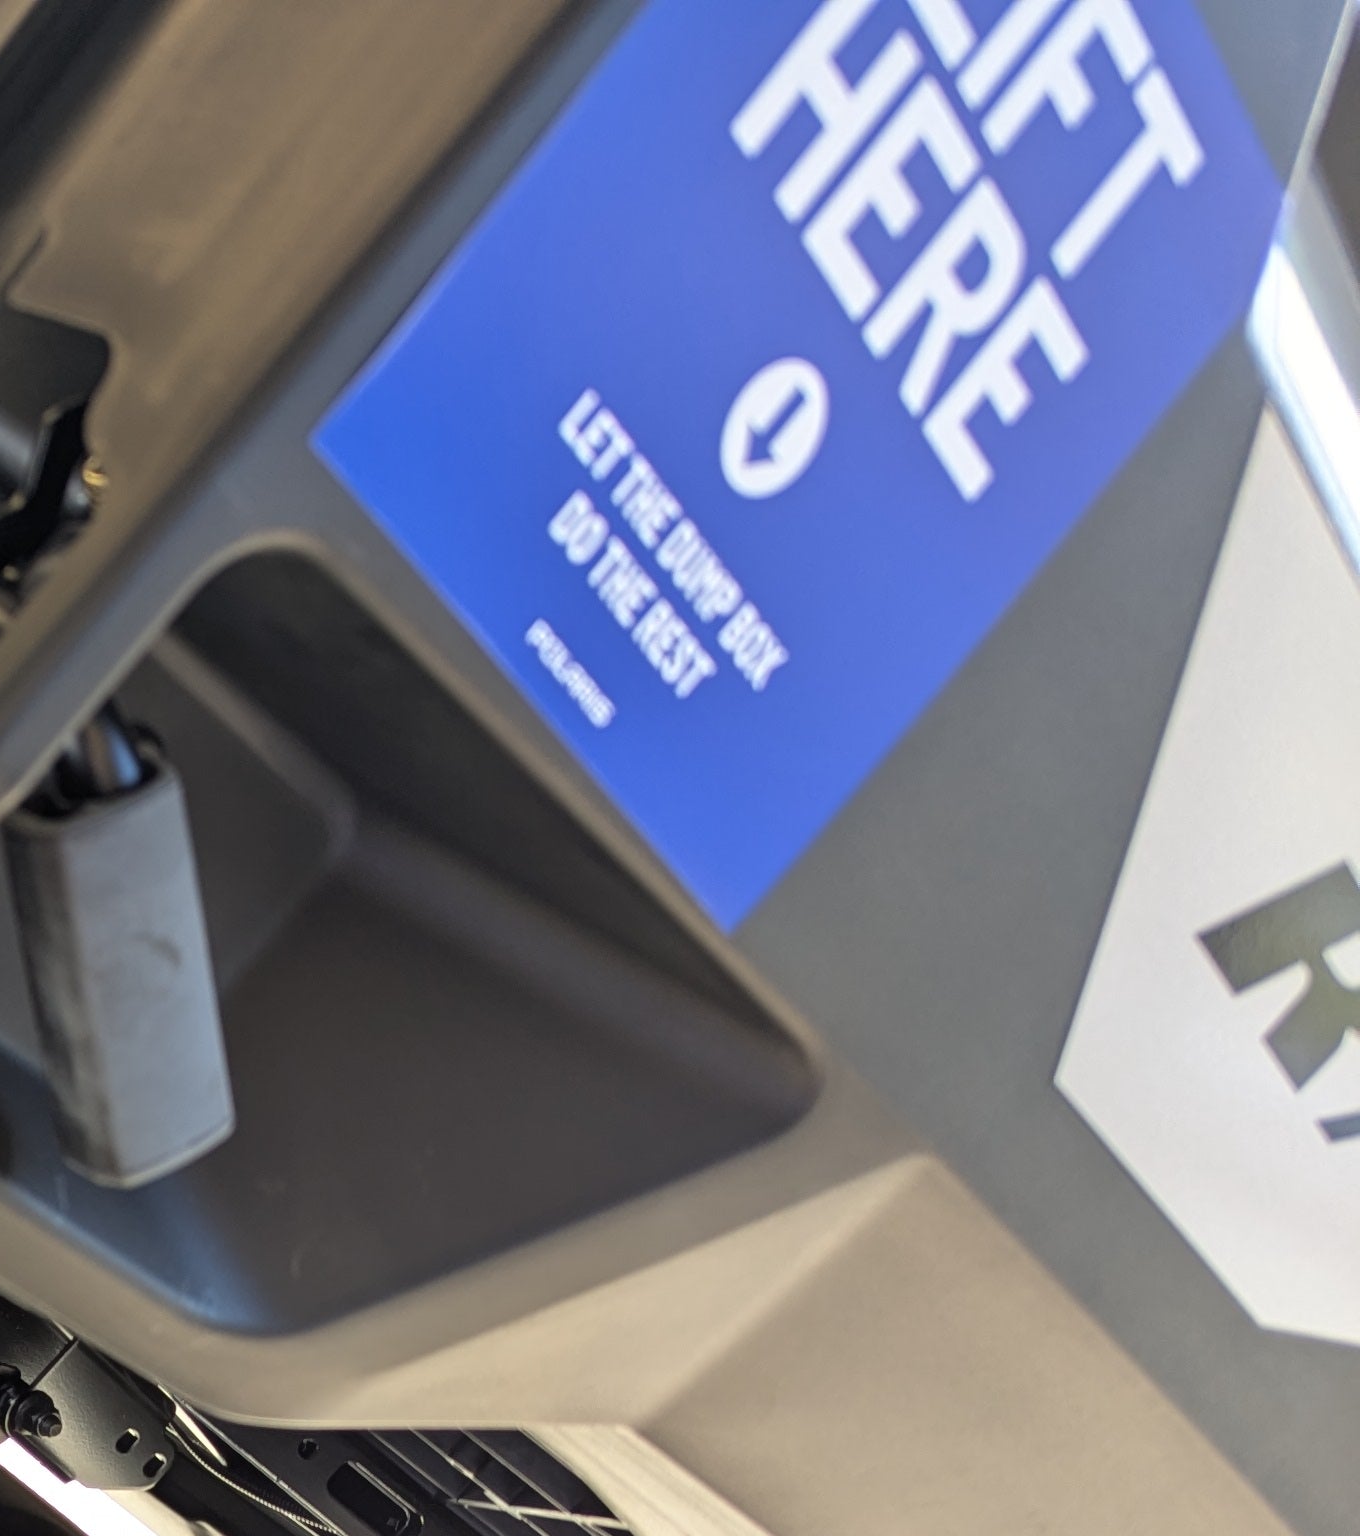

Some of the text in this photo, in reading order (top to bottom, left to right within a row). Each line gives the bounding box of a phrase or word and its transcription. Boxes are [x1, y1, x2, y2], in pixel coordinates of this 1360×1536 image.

[729, 0, 1090, 504] HERE
[548, 489, 718, 699] DO THE REST
[557, 386, 789, 692] LET THE DUMP BOX
[524, 617, 616, 729] POLARIS
